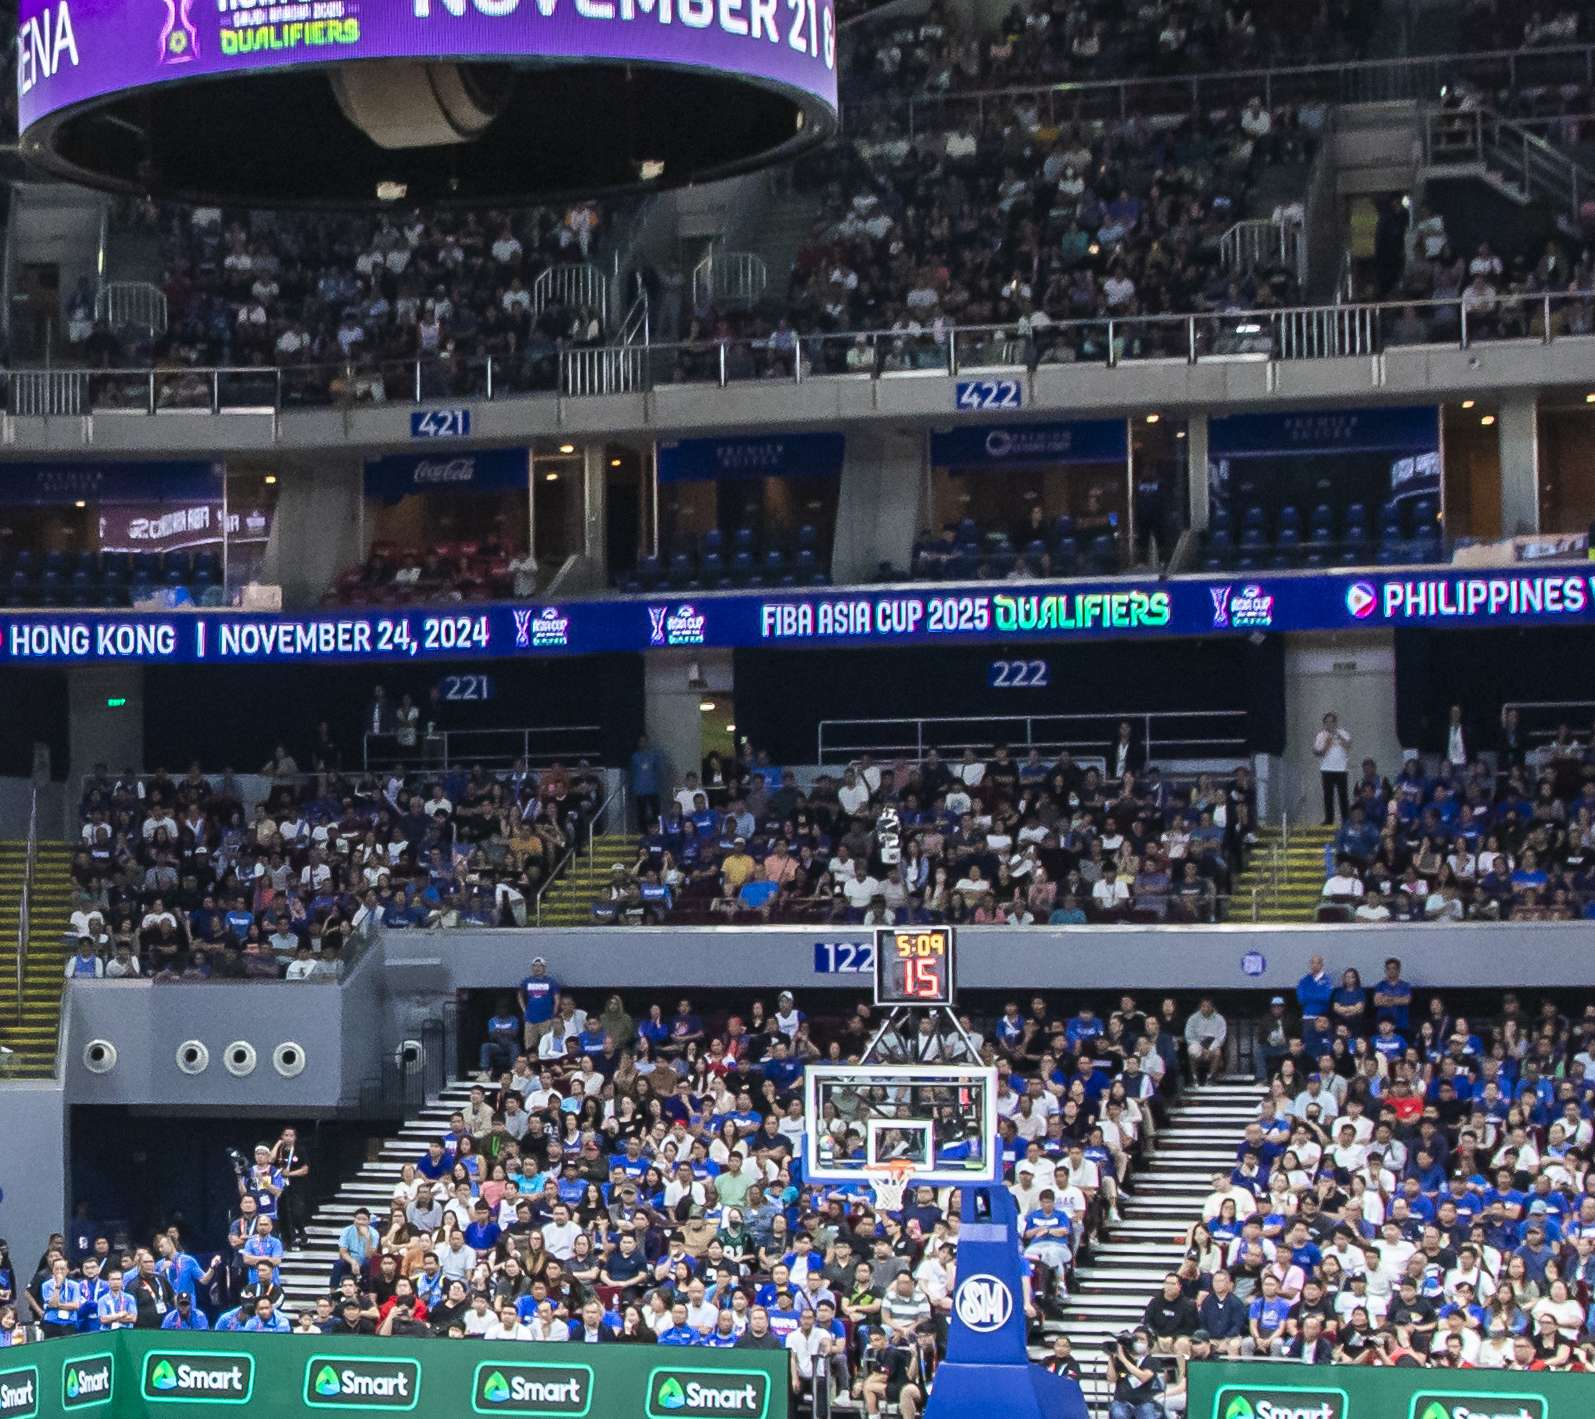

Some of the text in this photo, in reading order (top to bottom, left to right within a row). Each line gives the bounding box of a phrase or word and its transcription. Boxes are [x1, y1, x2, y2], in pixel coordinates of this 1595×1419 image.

[219, 16, 361, 56] QUALIFIERS
[958, 383, 1020, 411] 422
[416, 411, 468, 437] 421
[762, 588, 1171, 637] FIBA ASIA CUP 2025 QUALIFIERS
[1381, 579, 1588, 617] PHILIPPINES
[10, 624, 90, 658] HONG
[94, 624, 177, 658] KONG
[219, 618, 371, 655] NOVEMBER
[376, 618, 418, 656] 24,
[423, 615, 490, 652] 2024
[445, 673, 490, 702] 221
[991, 660, 1049, 688] 222
[824, 942, 874, 973] 122
[895, 933, 944, 960] 5:09
[904, 958, 941, 998] 15
[957, 1280, 1008, 1328] SM
[77, 1366, 109, 1396] Smart
[177, 1361, 243, 1390] Smart
[341, 1368, 409, 1396] Smart
[508, 1376, 580, 1403] Smart
[0, 1380, 35, 1410] Smart
[686, 1381, 757, 1410] Smart
